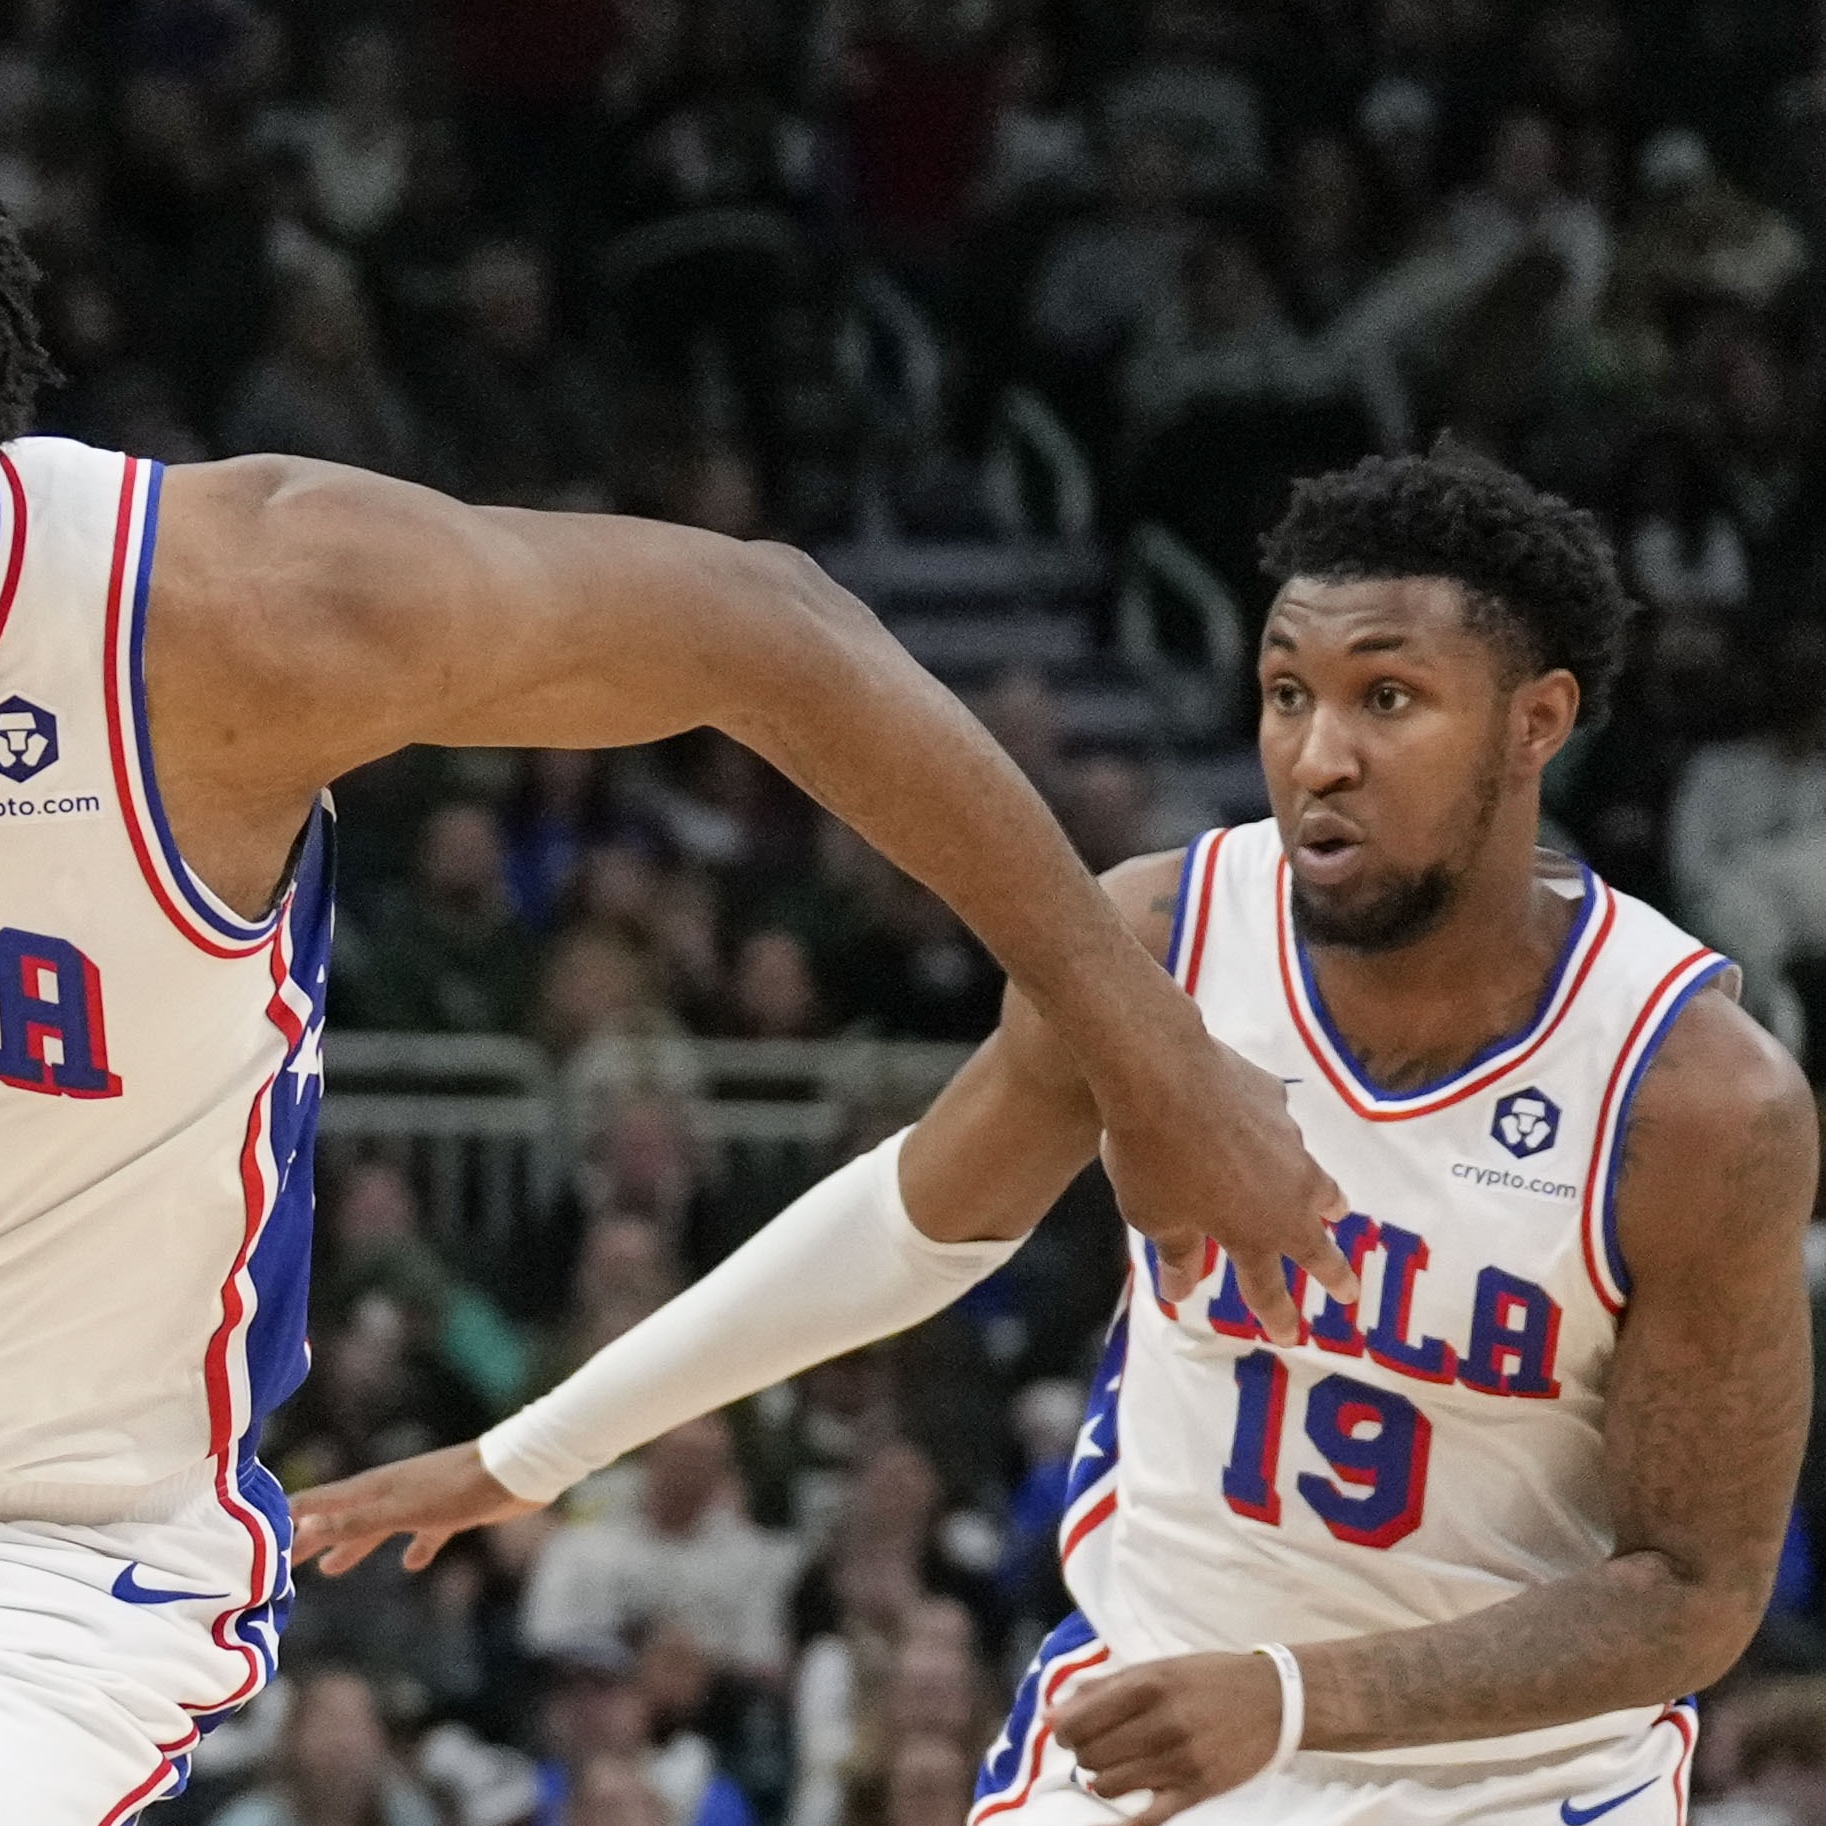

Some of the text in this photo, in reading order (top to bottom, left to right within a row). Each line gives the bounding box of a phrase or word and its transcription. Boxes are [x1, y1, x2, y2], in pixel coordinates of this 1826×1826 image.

[1452, 1161, 1577, 1199] crypto.com
[1201, 1209, 1561, 1399] ILA
[1223, 1348, 1432, 1551] 19
